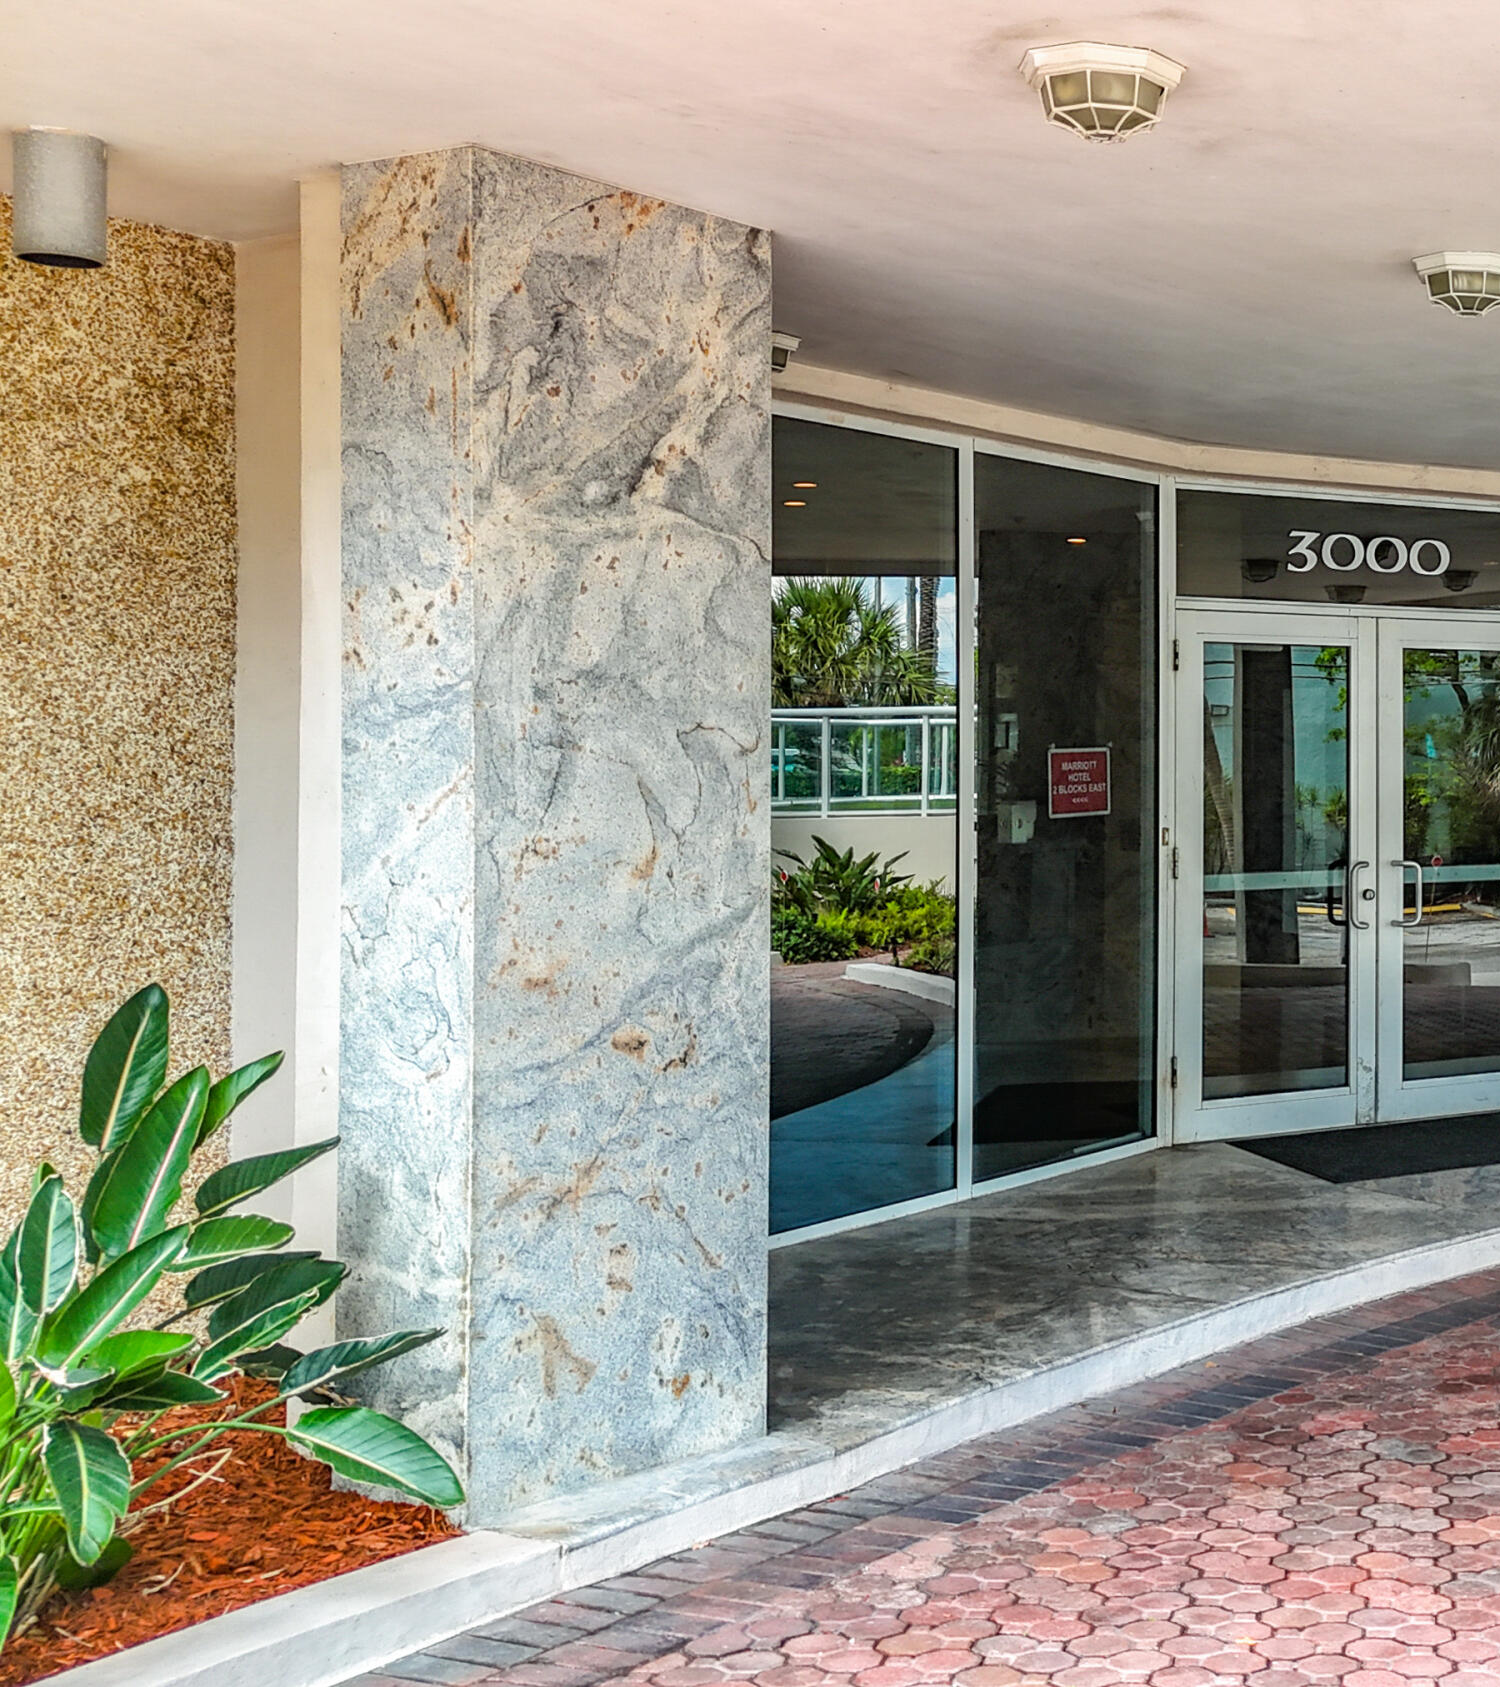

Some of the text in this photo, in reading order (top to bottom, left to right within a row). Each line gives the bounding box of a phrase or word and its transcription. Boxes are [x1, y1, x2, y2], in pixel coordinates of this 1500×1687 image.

[1286, 529, 1451, 576] 3000
[1061, 760, 1097, 771] MARRIOTT
[1067, 772, 1092, 782] HOTEL
[1052, 783, 1106, 795] 2 BLOCKS EAST
